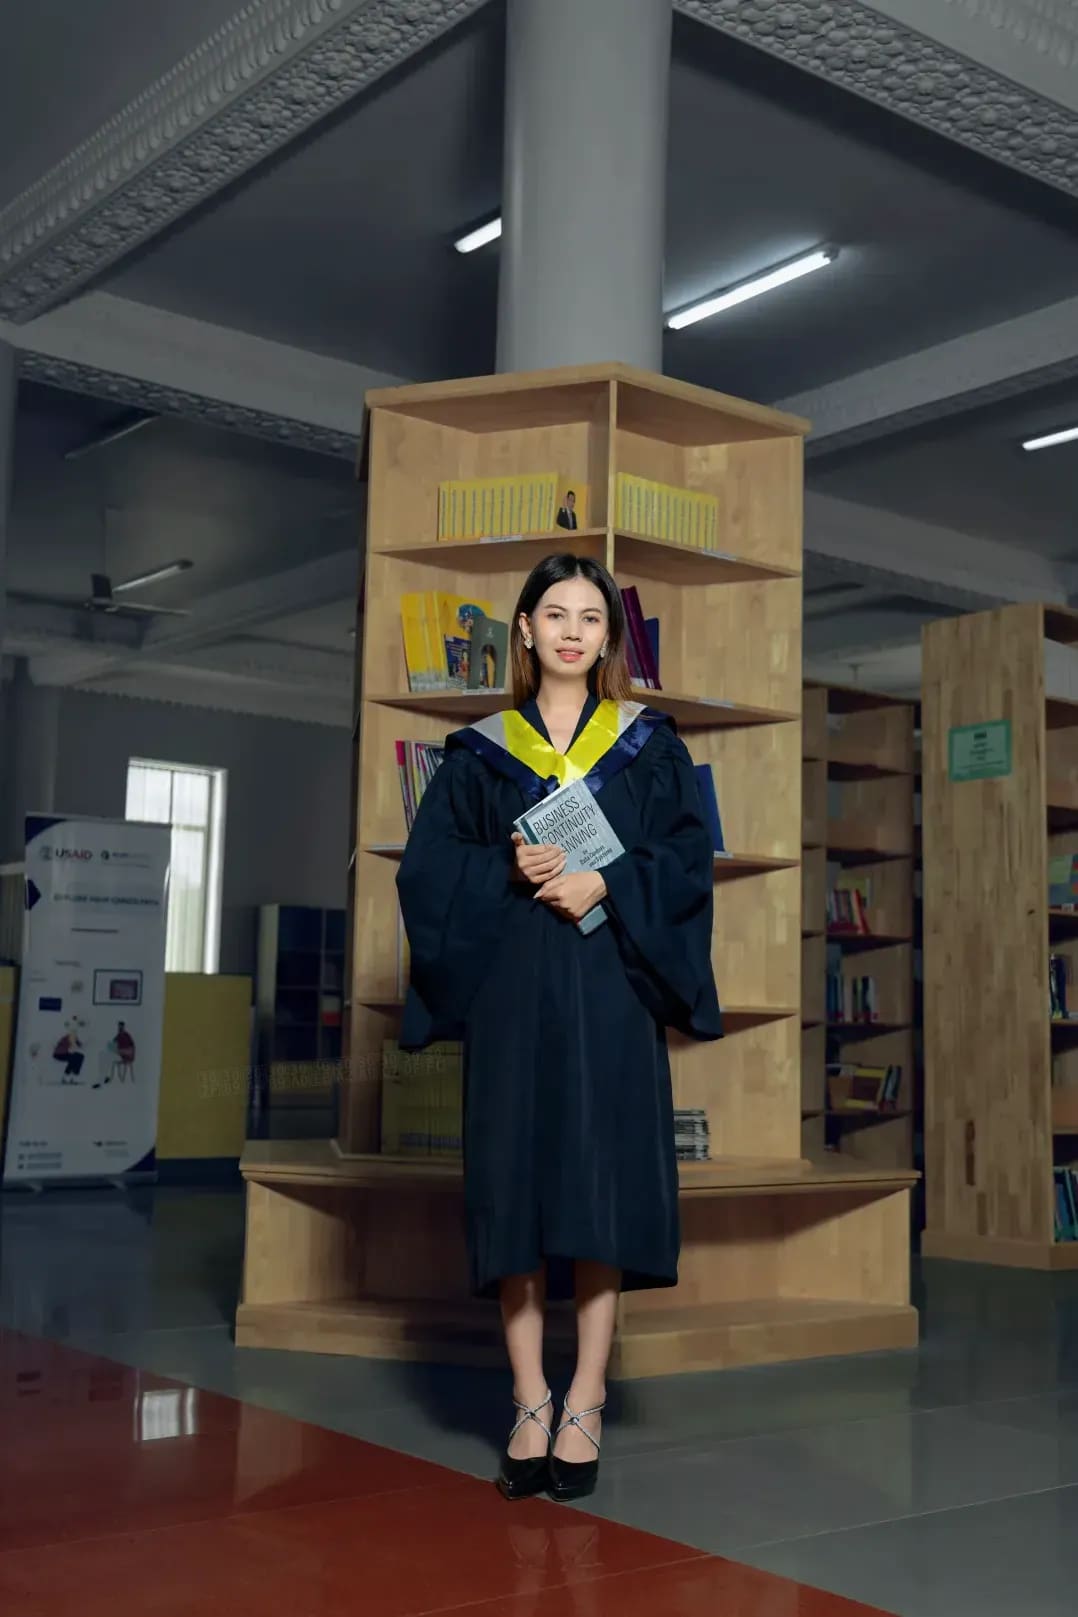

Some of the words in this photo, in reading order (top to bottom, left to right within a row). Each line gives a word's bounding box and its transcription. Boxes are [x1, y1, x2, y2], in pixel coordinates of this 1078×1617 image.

[533, 796, 580, 835] BUSINESS
[542, 803, 595, 846] CONTINUITY
[56, 848, 93, 860] USAID
[560, 823, 597, 853] ANNING
